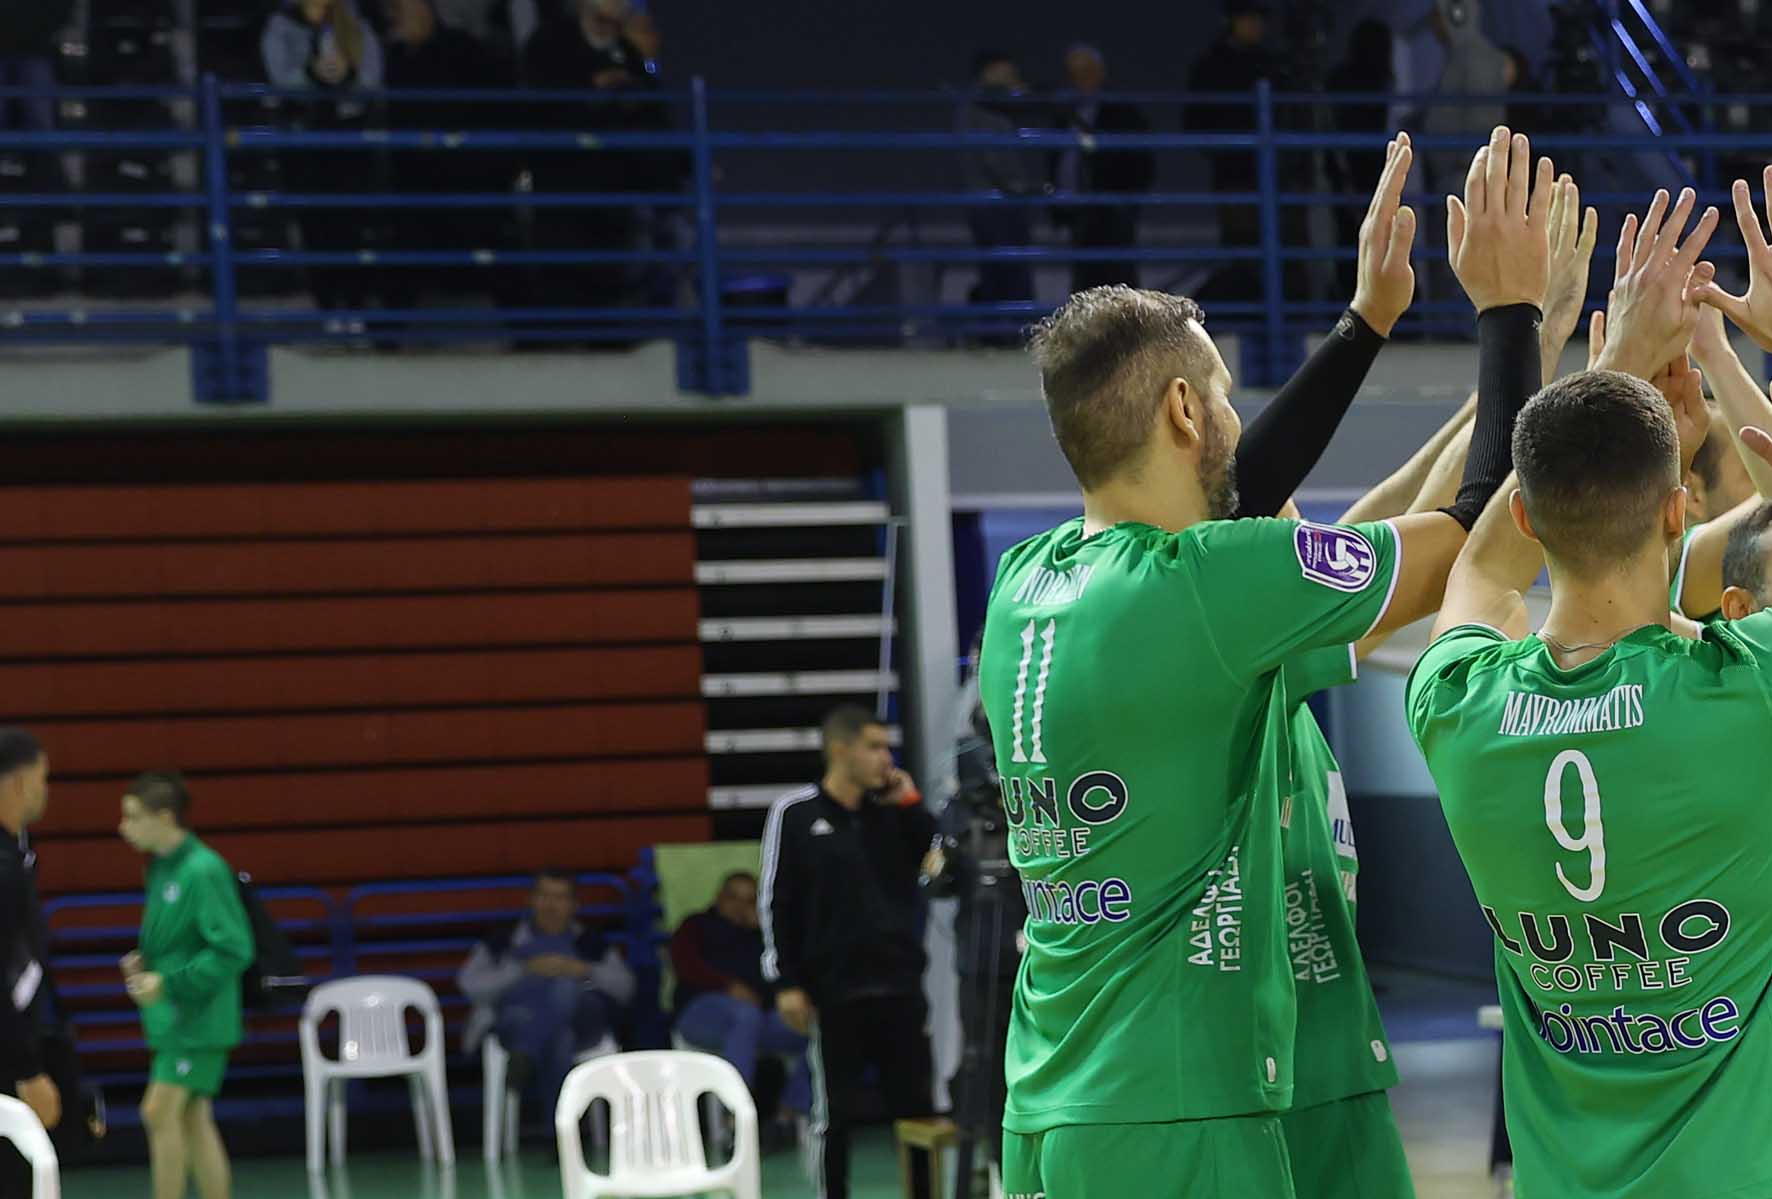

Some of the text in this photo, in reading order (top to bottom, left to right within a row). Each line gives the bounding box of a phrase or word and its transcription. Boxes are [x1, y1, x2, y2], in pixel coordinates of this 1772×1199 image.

[1011, 618, 1056, 762] 11
[1498, 684, 1645, 736] MAVROMMATIS
[1000, 770, 1128, 828] UNO
[1543, 749, 1606, 902] 9
[1017, 827, 1092, 858] OFFEE
[1481, 899, 1731, 964] LUNO
[1529, 956, 1693, 992] COFFEE
[1538, 995, 1742, 1055] ointace
